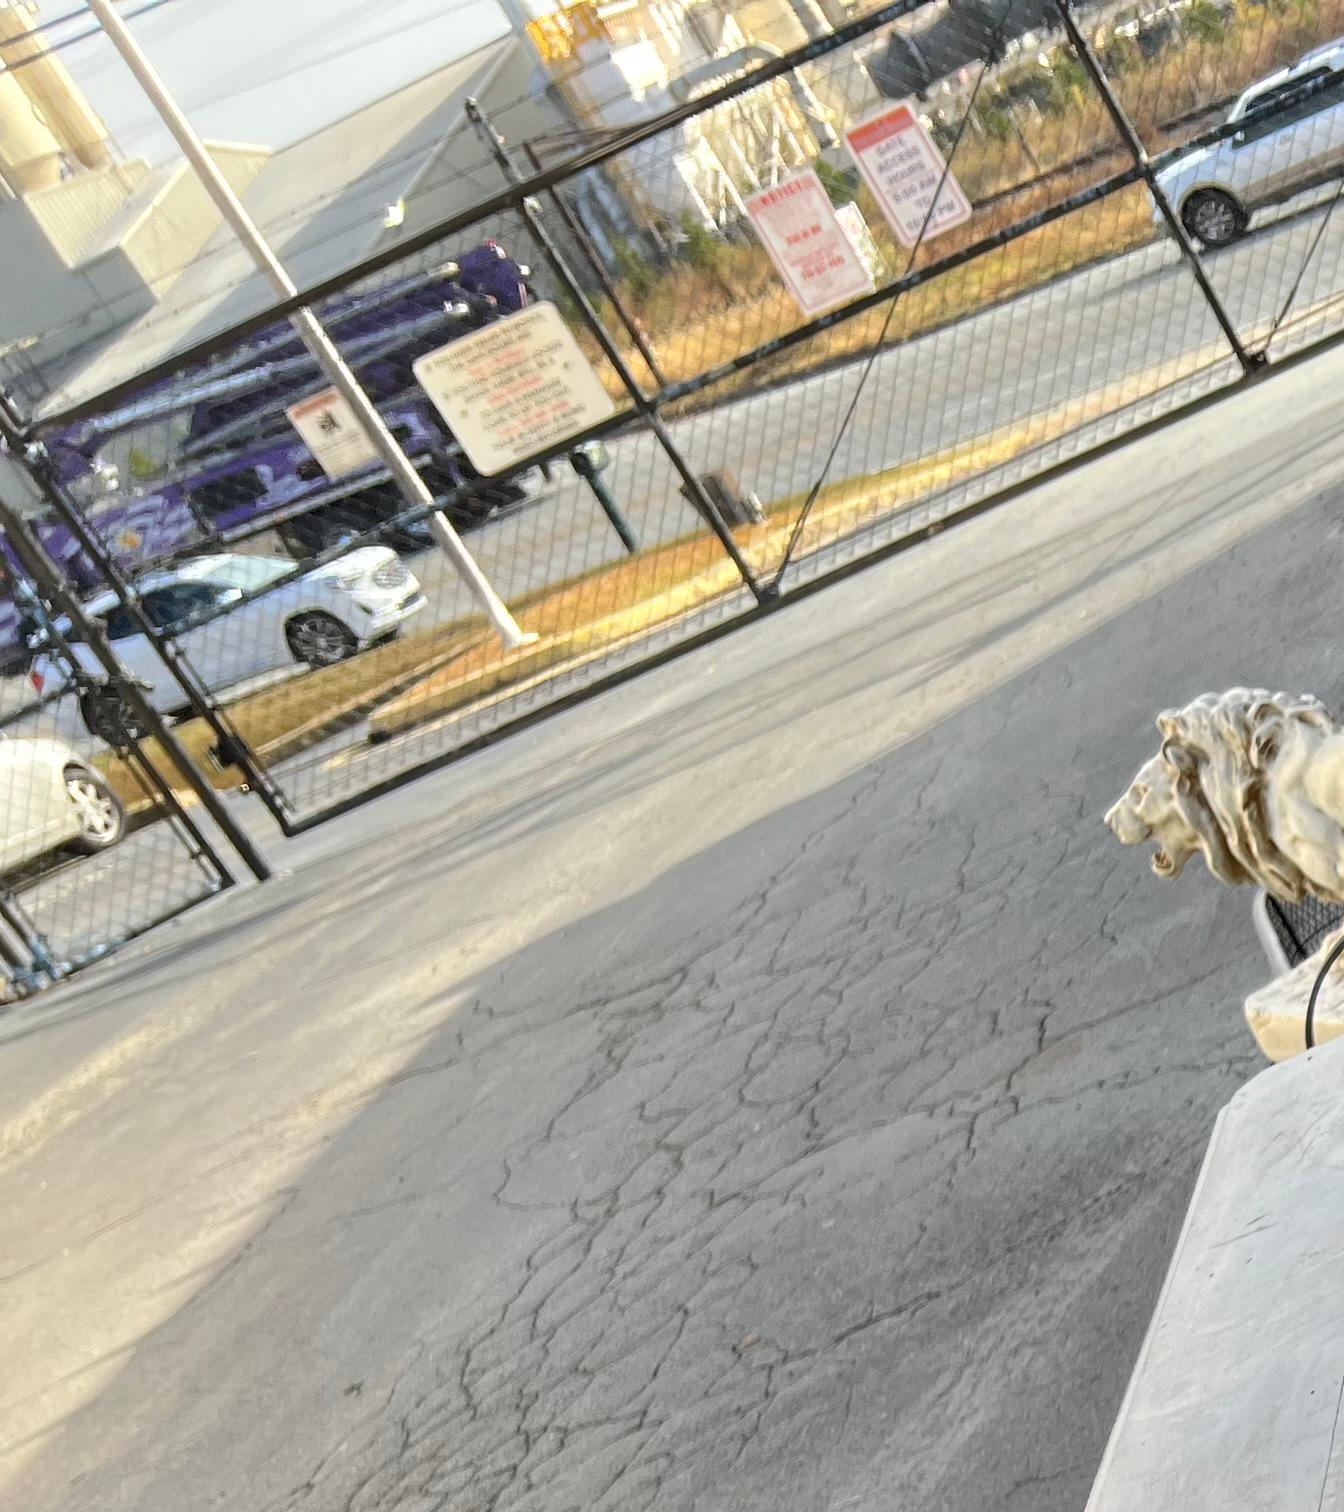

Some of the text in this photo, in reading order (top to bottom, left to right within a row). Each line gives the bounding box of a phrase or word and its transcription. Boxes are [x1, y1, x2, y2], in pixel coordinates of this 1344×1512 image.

[876, 134, 907, 155] GATE
[877, 145, 921, 174] ACCESS
[887, 160, 926, 185] HOURS
